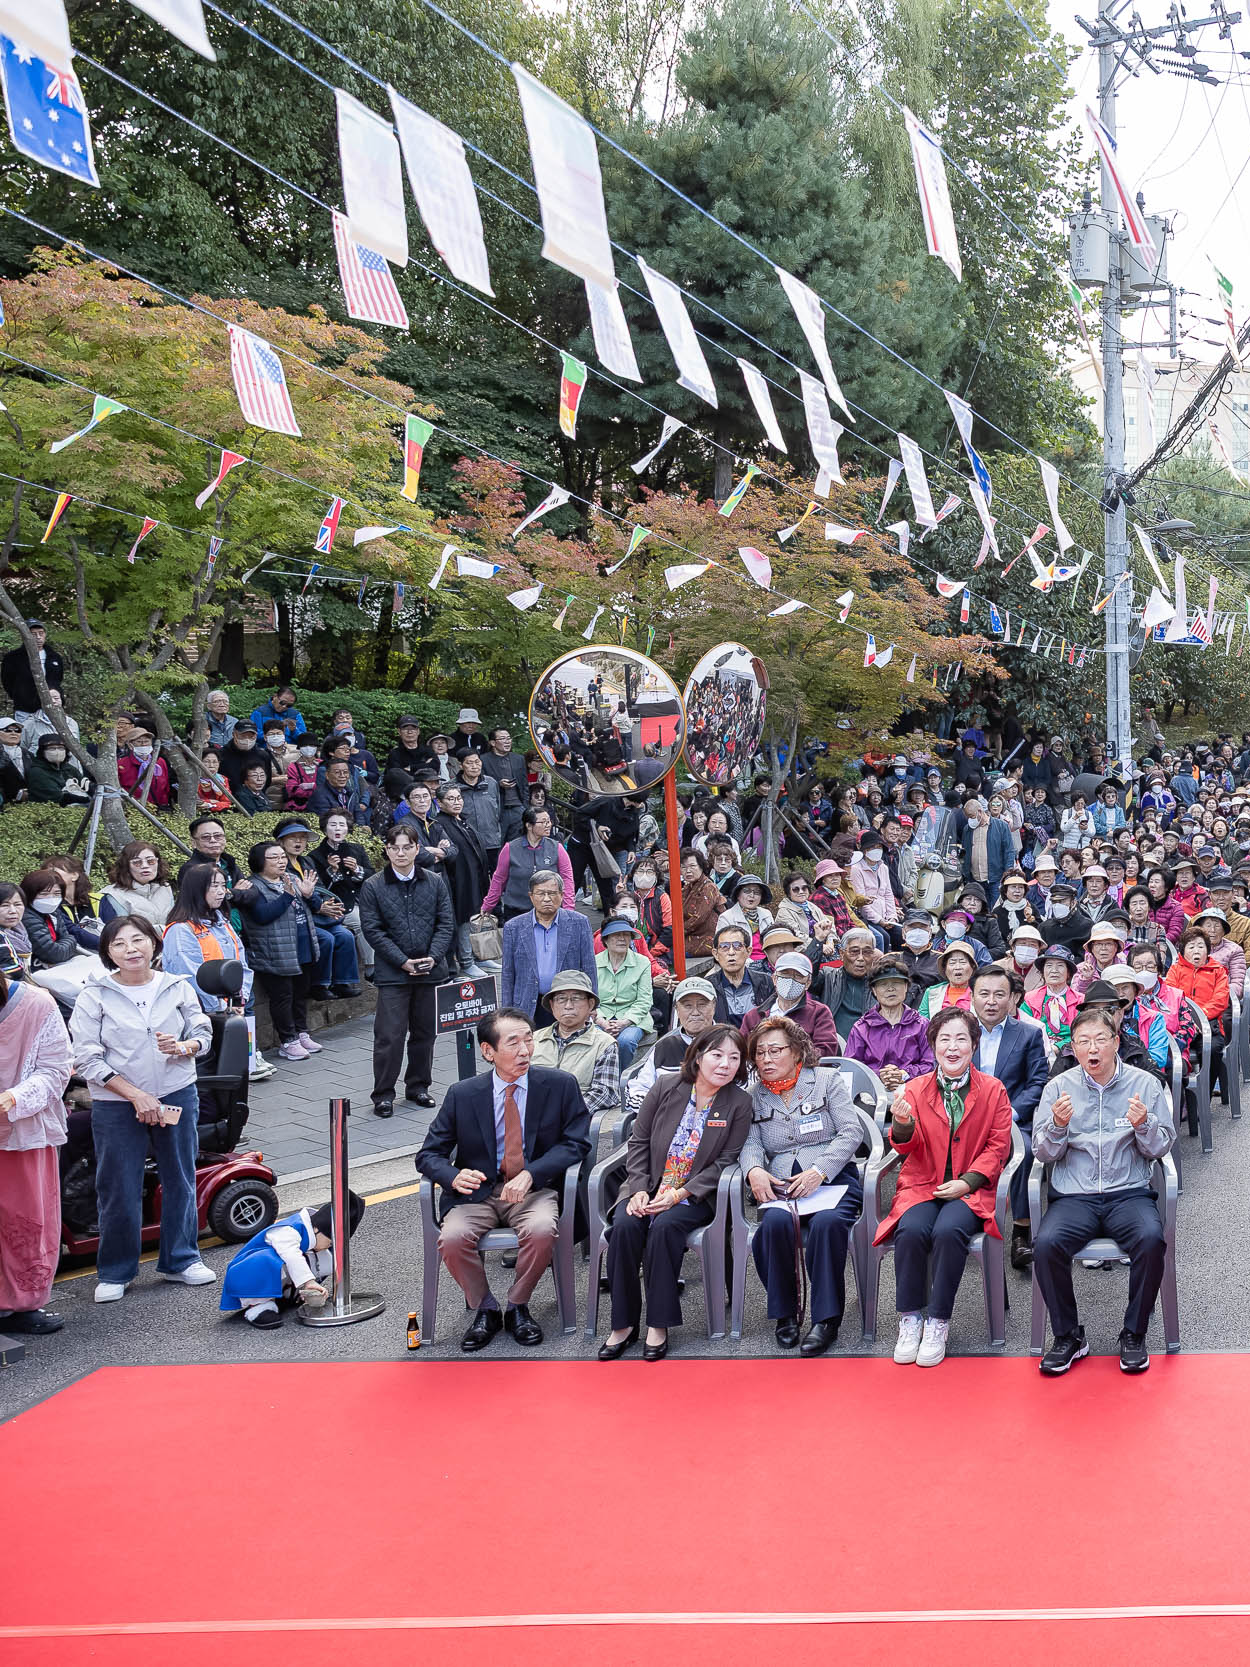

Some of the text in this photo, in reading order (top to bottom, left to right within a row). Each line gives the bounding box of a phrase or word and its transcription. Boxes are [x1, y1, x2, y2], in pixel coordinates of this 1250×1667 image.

[455, 999, 482, 1011] 오토바이
[440, 1012, 455, 1022] 진입
[457, 1011, 464, 1019] 및
[465, 1008, 480, 1017] 주차
